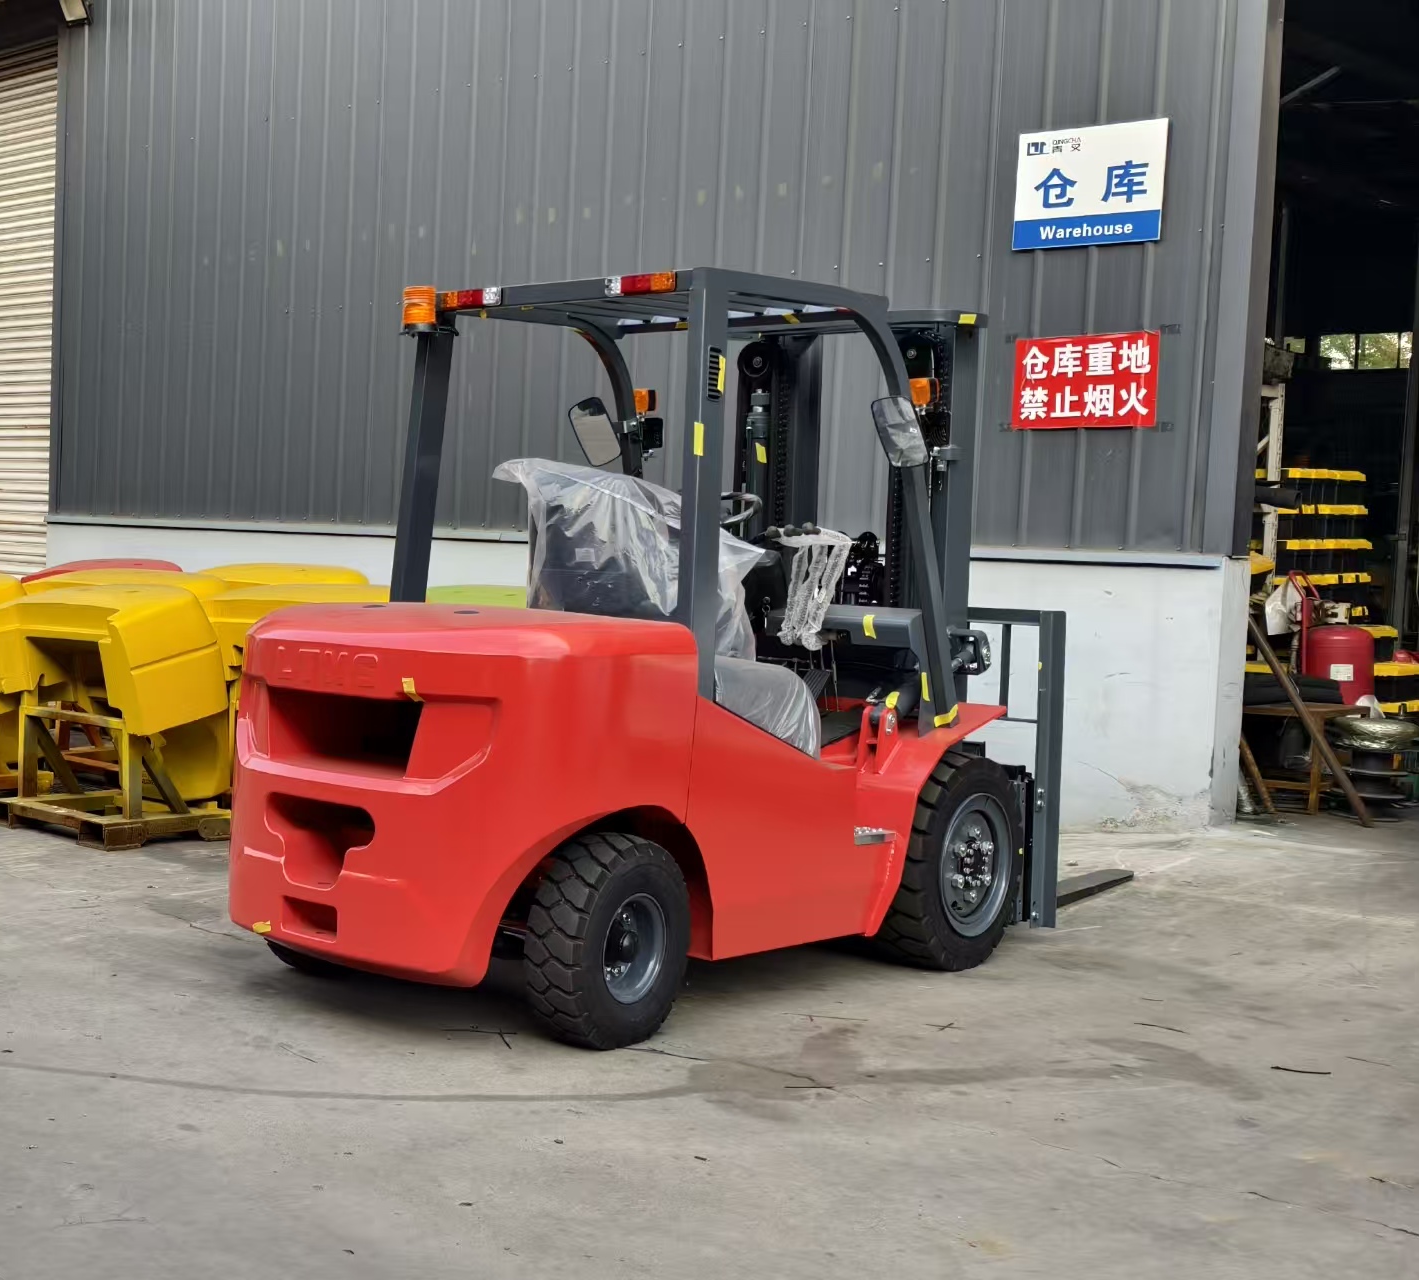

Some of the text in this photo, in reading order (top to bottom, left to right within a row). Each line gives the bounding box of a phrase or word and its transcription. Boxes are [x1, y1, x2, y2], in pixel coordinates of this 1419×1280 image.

[1034, 160, 1149, 208] 仓库
[1039, 223, 1134, 240] Warehouse
[1022, 340, 1151, 380] 仓库重地
[1020, 382, 1149, 420] 禁止烟火
